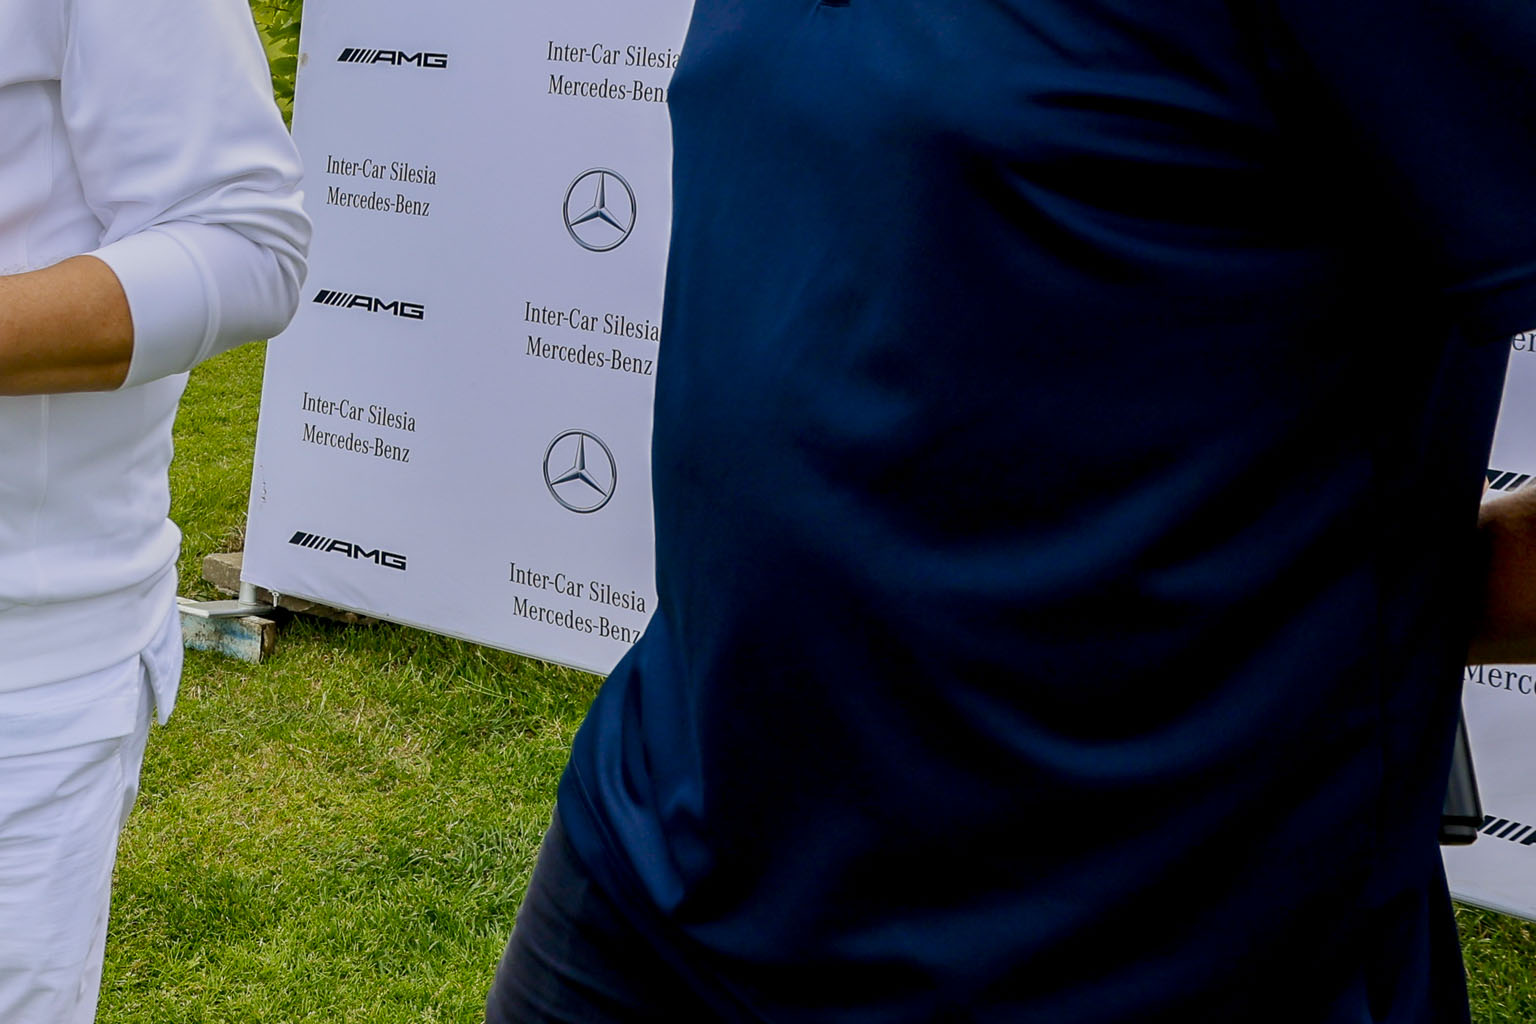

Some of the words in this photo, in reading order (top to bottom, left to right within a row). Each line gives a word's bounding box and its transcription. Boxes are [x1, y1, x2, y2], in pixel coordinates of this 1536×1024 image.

[372, 49, 448, 69] AMG
[547, 40, 620, 65] Inter-Car
[547, 74, 667, 104] Mercedes-Ben
[326, 155, 388, 180] Inter-Car
[390, 160, 437, 186] Silesia
[326, 186, 431, 217] Mercedes-Benz
[349, 294, 425, 321] AMG
[524, 301, 598, 332] Inter-Car
[603, 313, 660, 343] Silesia
[526, 334, 653, 376] Mercedes-Benz
[301, 392, 365, 422] Inter-Car
[368, 404, 417, 433] Silesia
[302, 422, 410, 464] Mercedes-Benz
[326, 539, 407, 571] AMG
[509, 562, 584, 598] Inter-Car
[589, 580, 646, 614] Silesia
[512, 595, 641, 645] Mercedes-Benz
